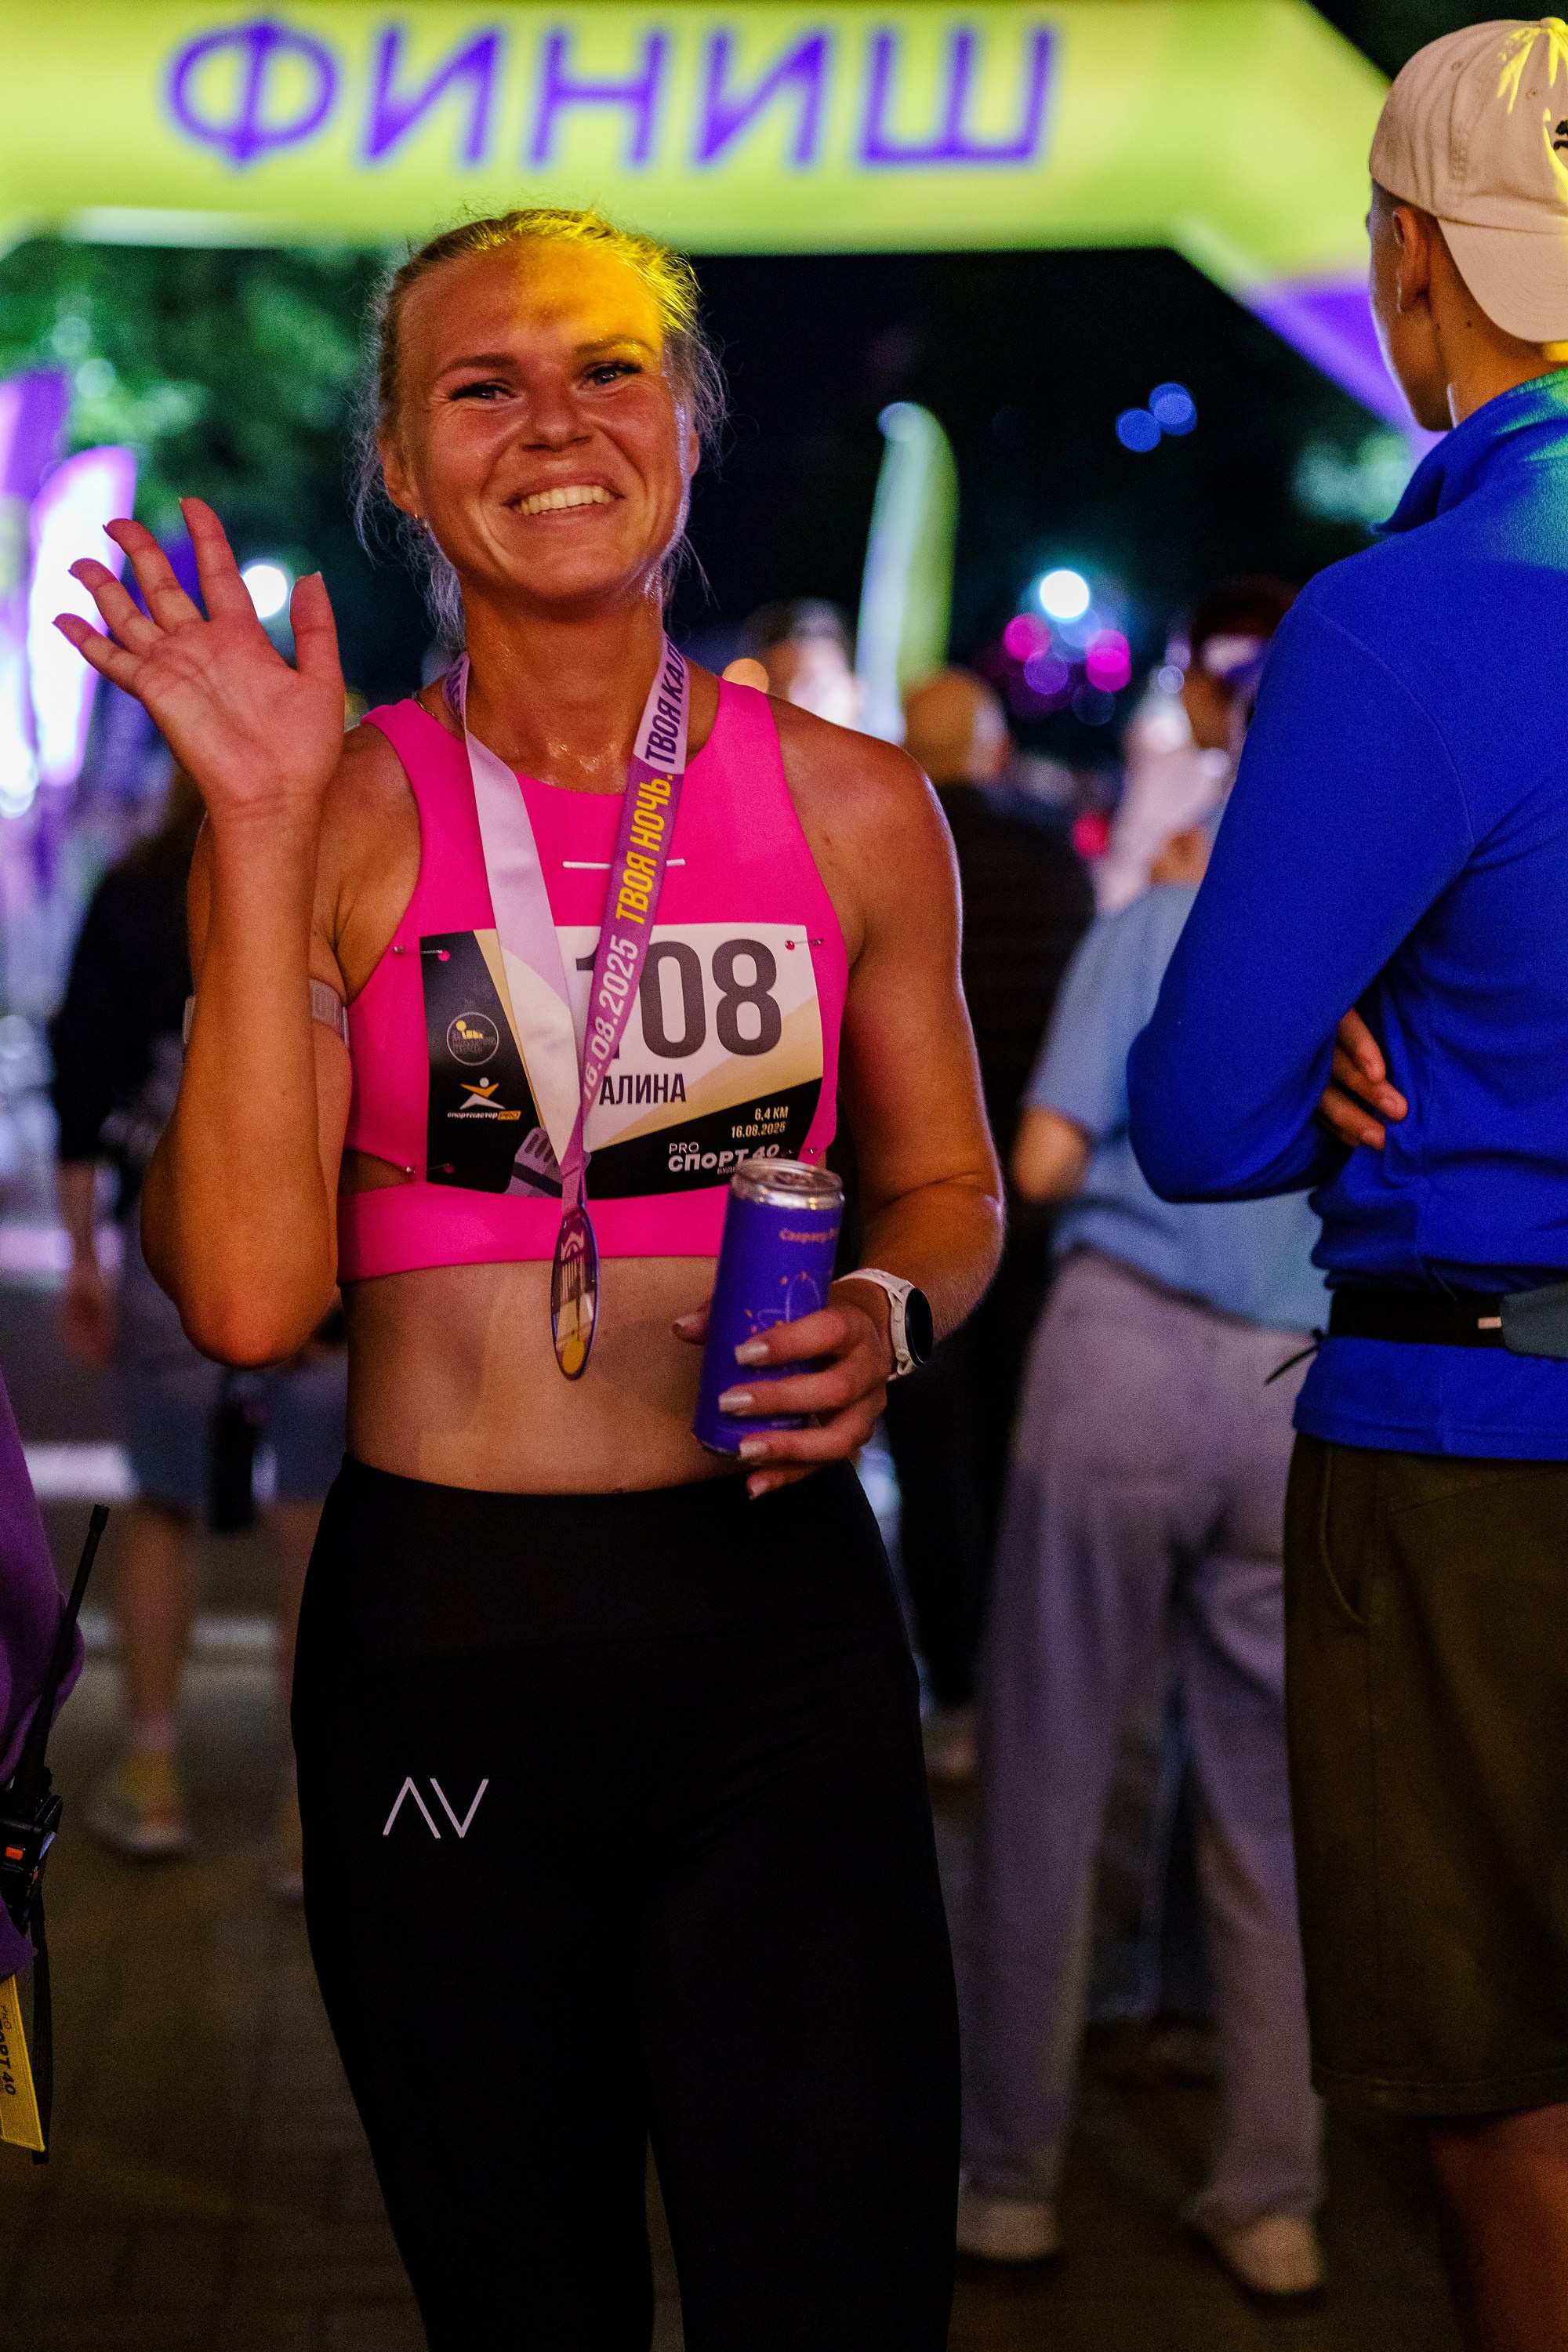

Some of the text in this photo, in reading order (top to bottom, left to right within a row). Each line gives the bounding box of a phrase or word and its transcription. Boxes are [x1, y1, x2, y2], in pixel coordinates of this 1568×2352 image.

[166, 19, 1058, 168] ФИНИШ
[660, 640, 684, 704] КАЛ
[644, 695, 681, 765] ТВОЯ
[630, 775, 673, 851] НОЧЬ.
[615, 851, 657, 925] ТВОЯ
[599, 1073, 687, 1105] АЛИНА
[668, 1148, 750, 1173] СПОРТ
[751, 1143, 780, 1160] 40
[669, 1142, 699, 1155] PRO
[731, 1121, 786, 1138] 16.08.2025
